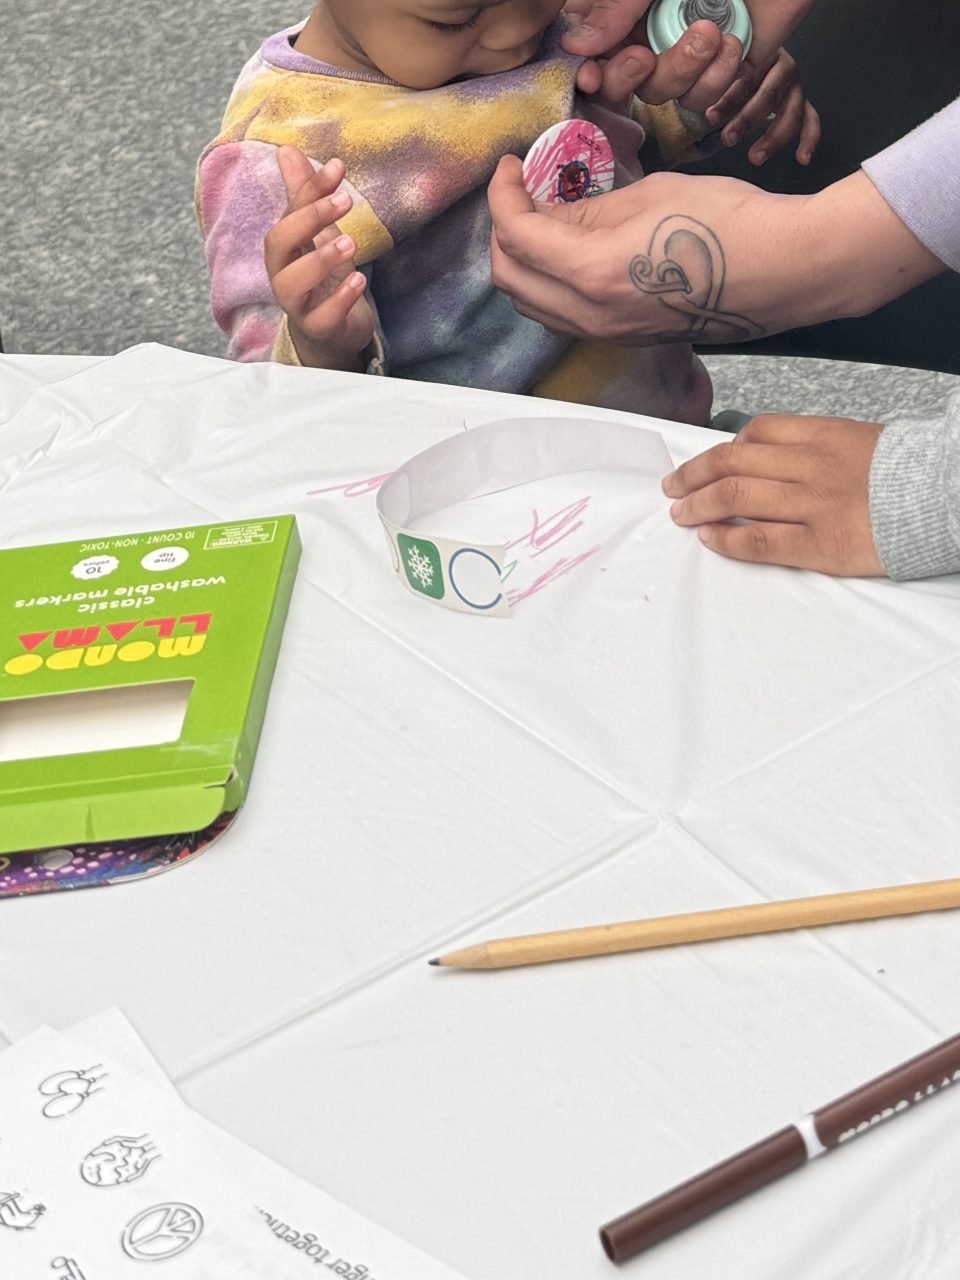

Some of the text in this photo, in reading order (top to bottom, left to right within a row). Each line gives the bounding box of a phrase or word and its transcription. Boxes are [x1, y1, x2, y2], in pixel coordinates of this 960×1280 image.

[180, 531, 194, 539] 10
[86, 565, 103, 574] 10
[15, 575, 226, 608] washable markers
[78, 596, 155, 613] classic
[18, 613, 212, 652] LLAMA
[5, 634, 207, 675] MONDO
